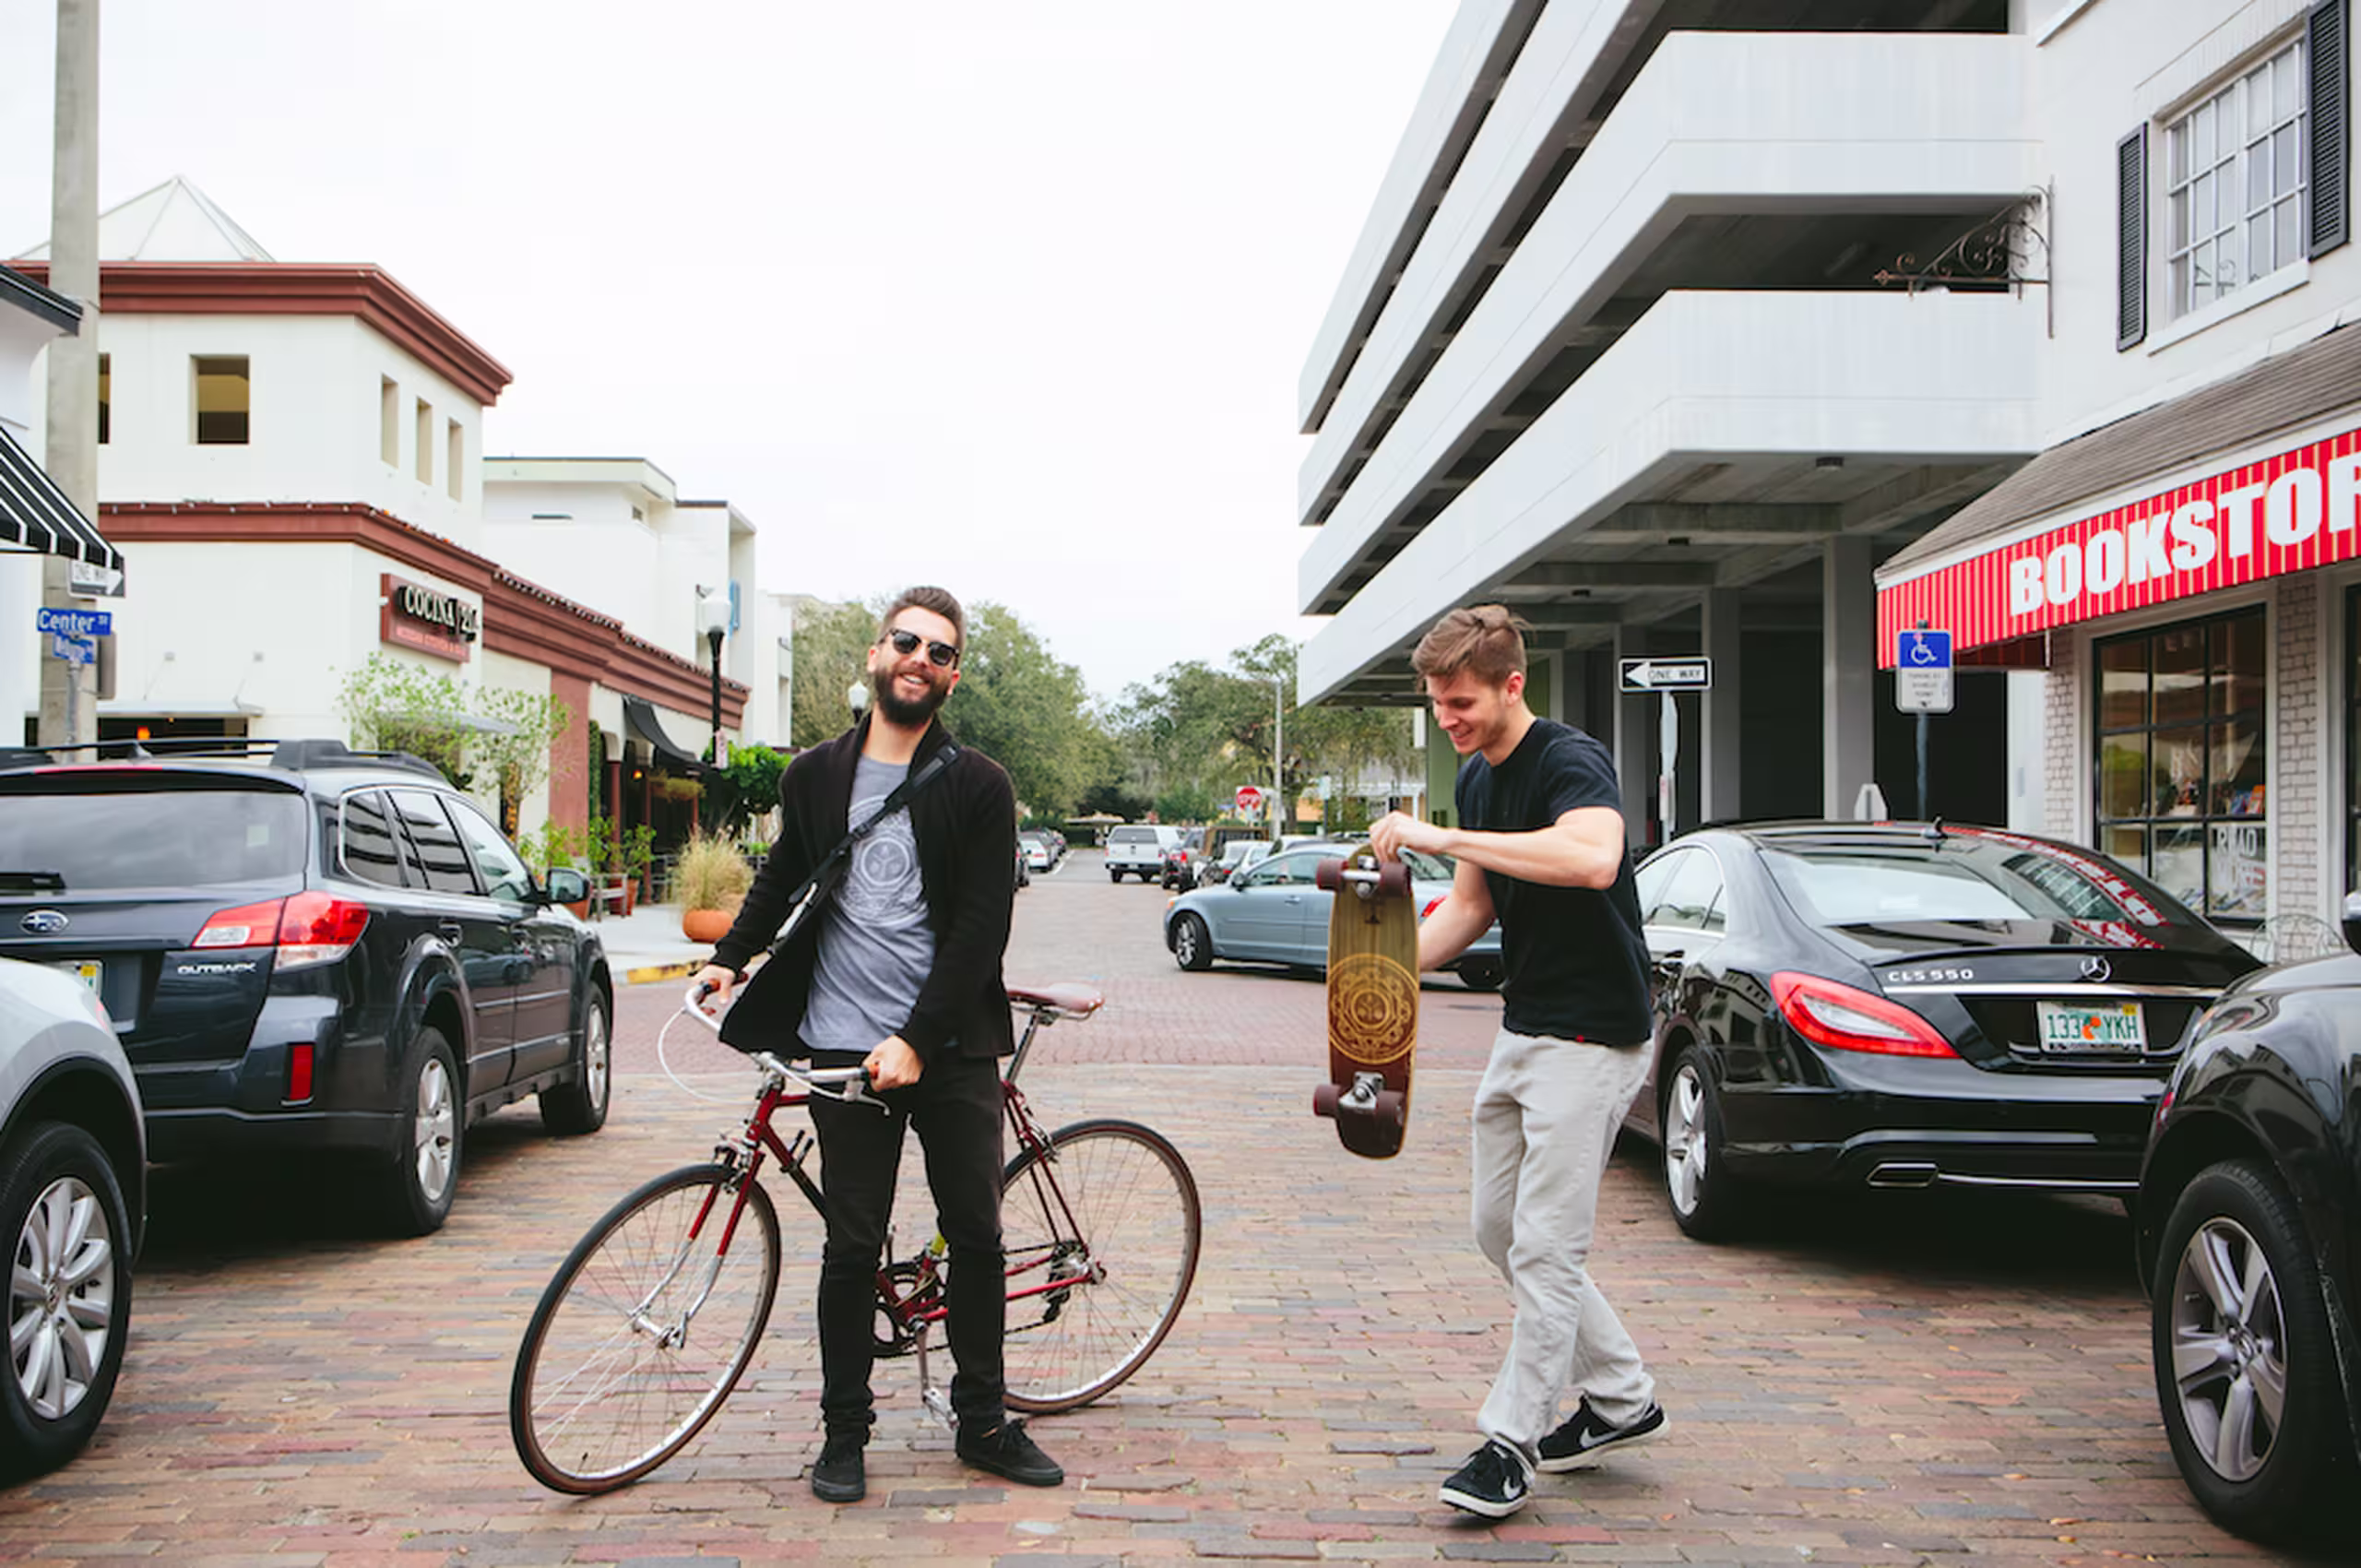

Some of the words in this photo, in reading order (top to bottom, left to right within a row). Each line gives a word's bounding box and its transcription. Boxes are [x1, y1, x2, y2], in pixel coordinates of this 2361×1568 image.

[40, 610, 95, 632] Center
[1647, 670, 1671, 681] ONE
[1679, 669, 1702, 680] WAY
[177, 962, 256, 975] OUTBACK
[1888, 970, 1926, 982] CLS
[1929, 968, 1974, 981] 550
[2047, 1014, 2082, 1039] 133
[2103, 1015, 2139, 1039] YKH
